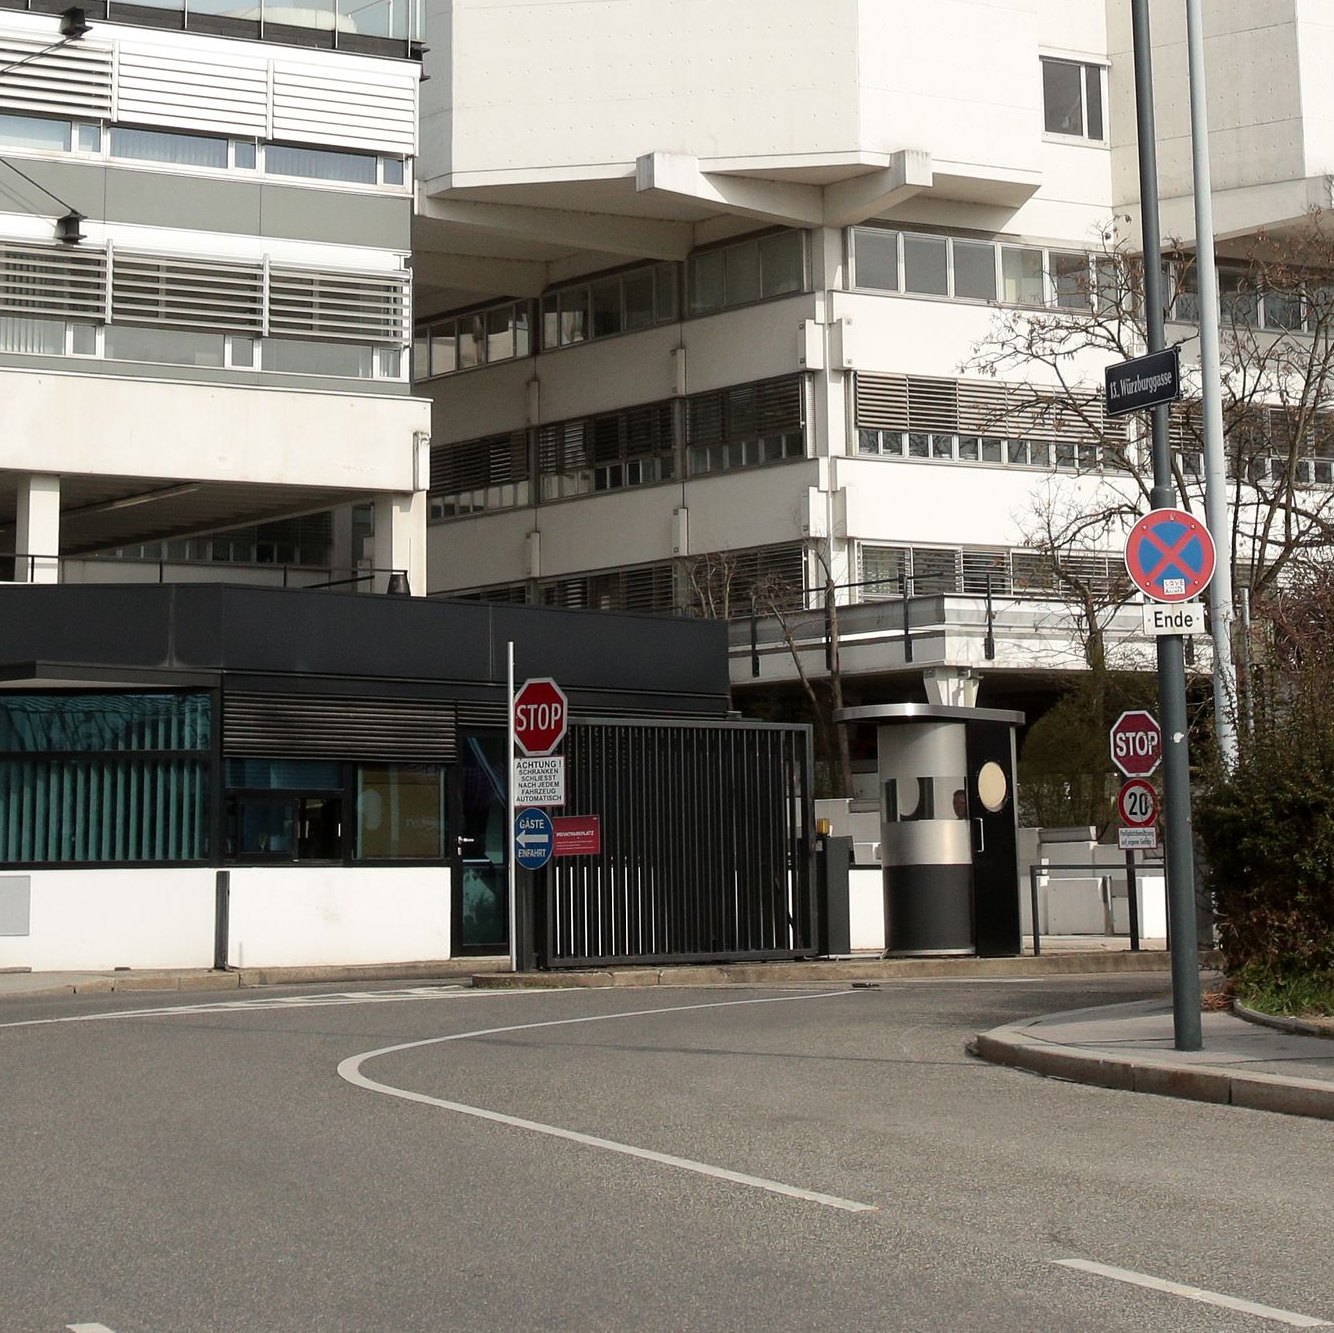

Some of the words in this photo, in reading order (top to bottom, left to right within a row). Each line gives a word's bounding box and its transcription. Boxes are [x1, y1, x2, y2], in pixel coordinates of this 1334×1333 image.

[1120, 371, 1172, 396] Würzburggasse
[1154, 610, 1193, 628] Ende
[516, 703, 562, 731] STOP
[1116, 731, 1158, 756] STOP
[516, 760, 557, 769] ACHTUNG
[518, 768, 559, 776] SCHRANKEN
[1128, 792, 1148, 816] 20
[519, 818, 544, 829] GÄSTE
[518, 849, 546, 858] EINFAHRT
